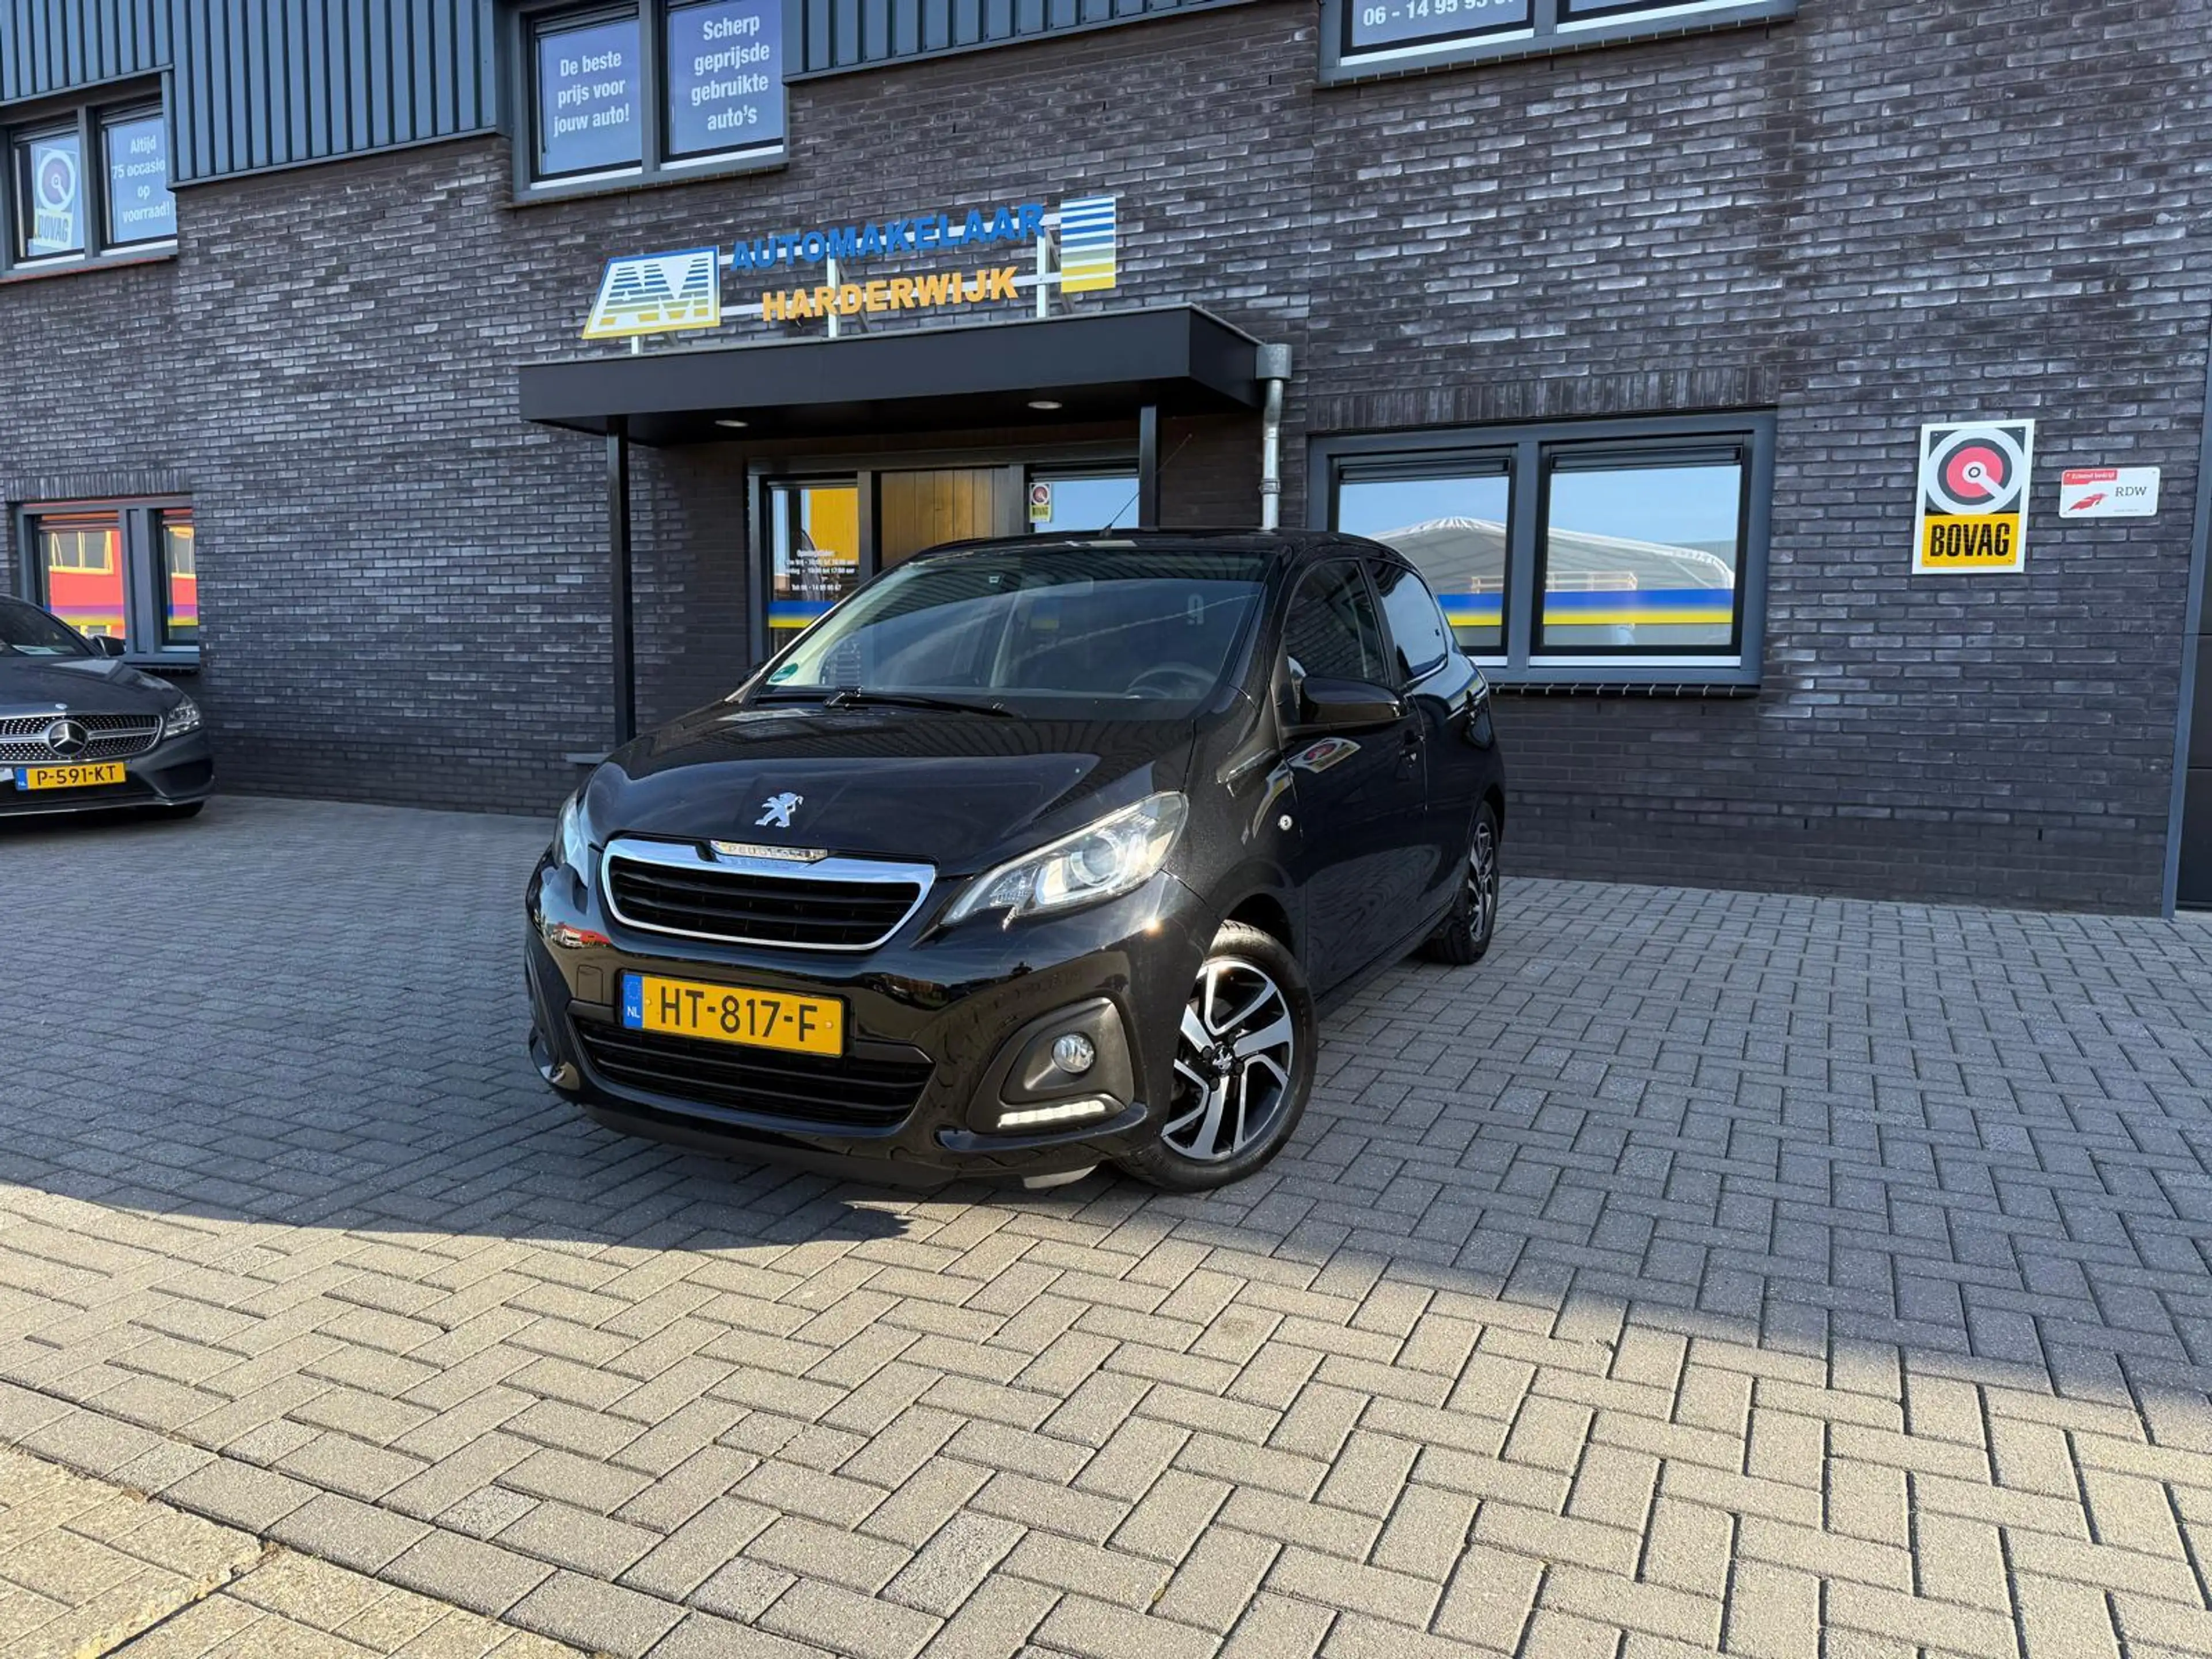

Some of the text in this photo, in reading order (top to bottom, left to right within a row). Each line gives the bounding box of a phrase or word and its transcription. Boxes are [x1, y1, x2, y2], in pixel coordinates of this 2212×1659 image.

[1363, 6, 1387, 26] 06
[1406, 0, 1429, 19] 14
[703, 15, 760, 40] Scherp
[560, 51, 622, 77] De beste
[694, 42, 770, 76] geprijsde
[558, 79, 626, 109] prijs voor
[691, 73, 769, 106] gebruikte
[554, 103, 630, 138] jouw auto!
[707, 104, 757, 131] auto's
[130, 135, 156, 154] Altijd
[111, 164, 125, 180] 75
[137, 185, 150, 200] op
[122, 201, 170, 224] voorraad!
[729, 203, 1045, 271] AUTOMAKELAAR
[762, 266, 1018, 322] HARDERWIJK
[2115, 486, 2147, 497] RDW
[1930, 522, 2011, 557] BOVAG
[36, 765, 116, 786] P-591-KT
[627, 986, 818, 1042] NL HT-817-F
